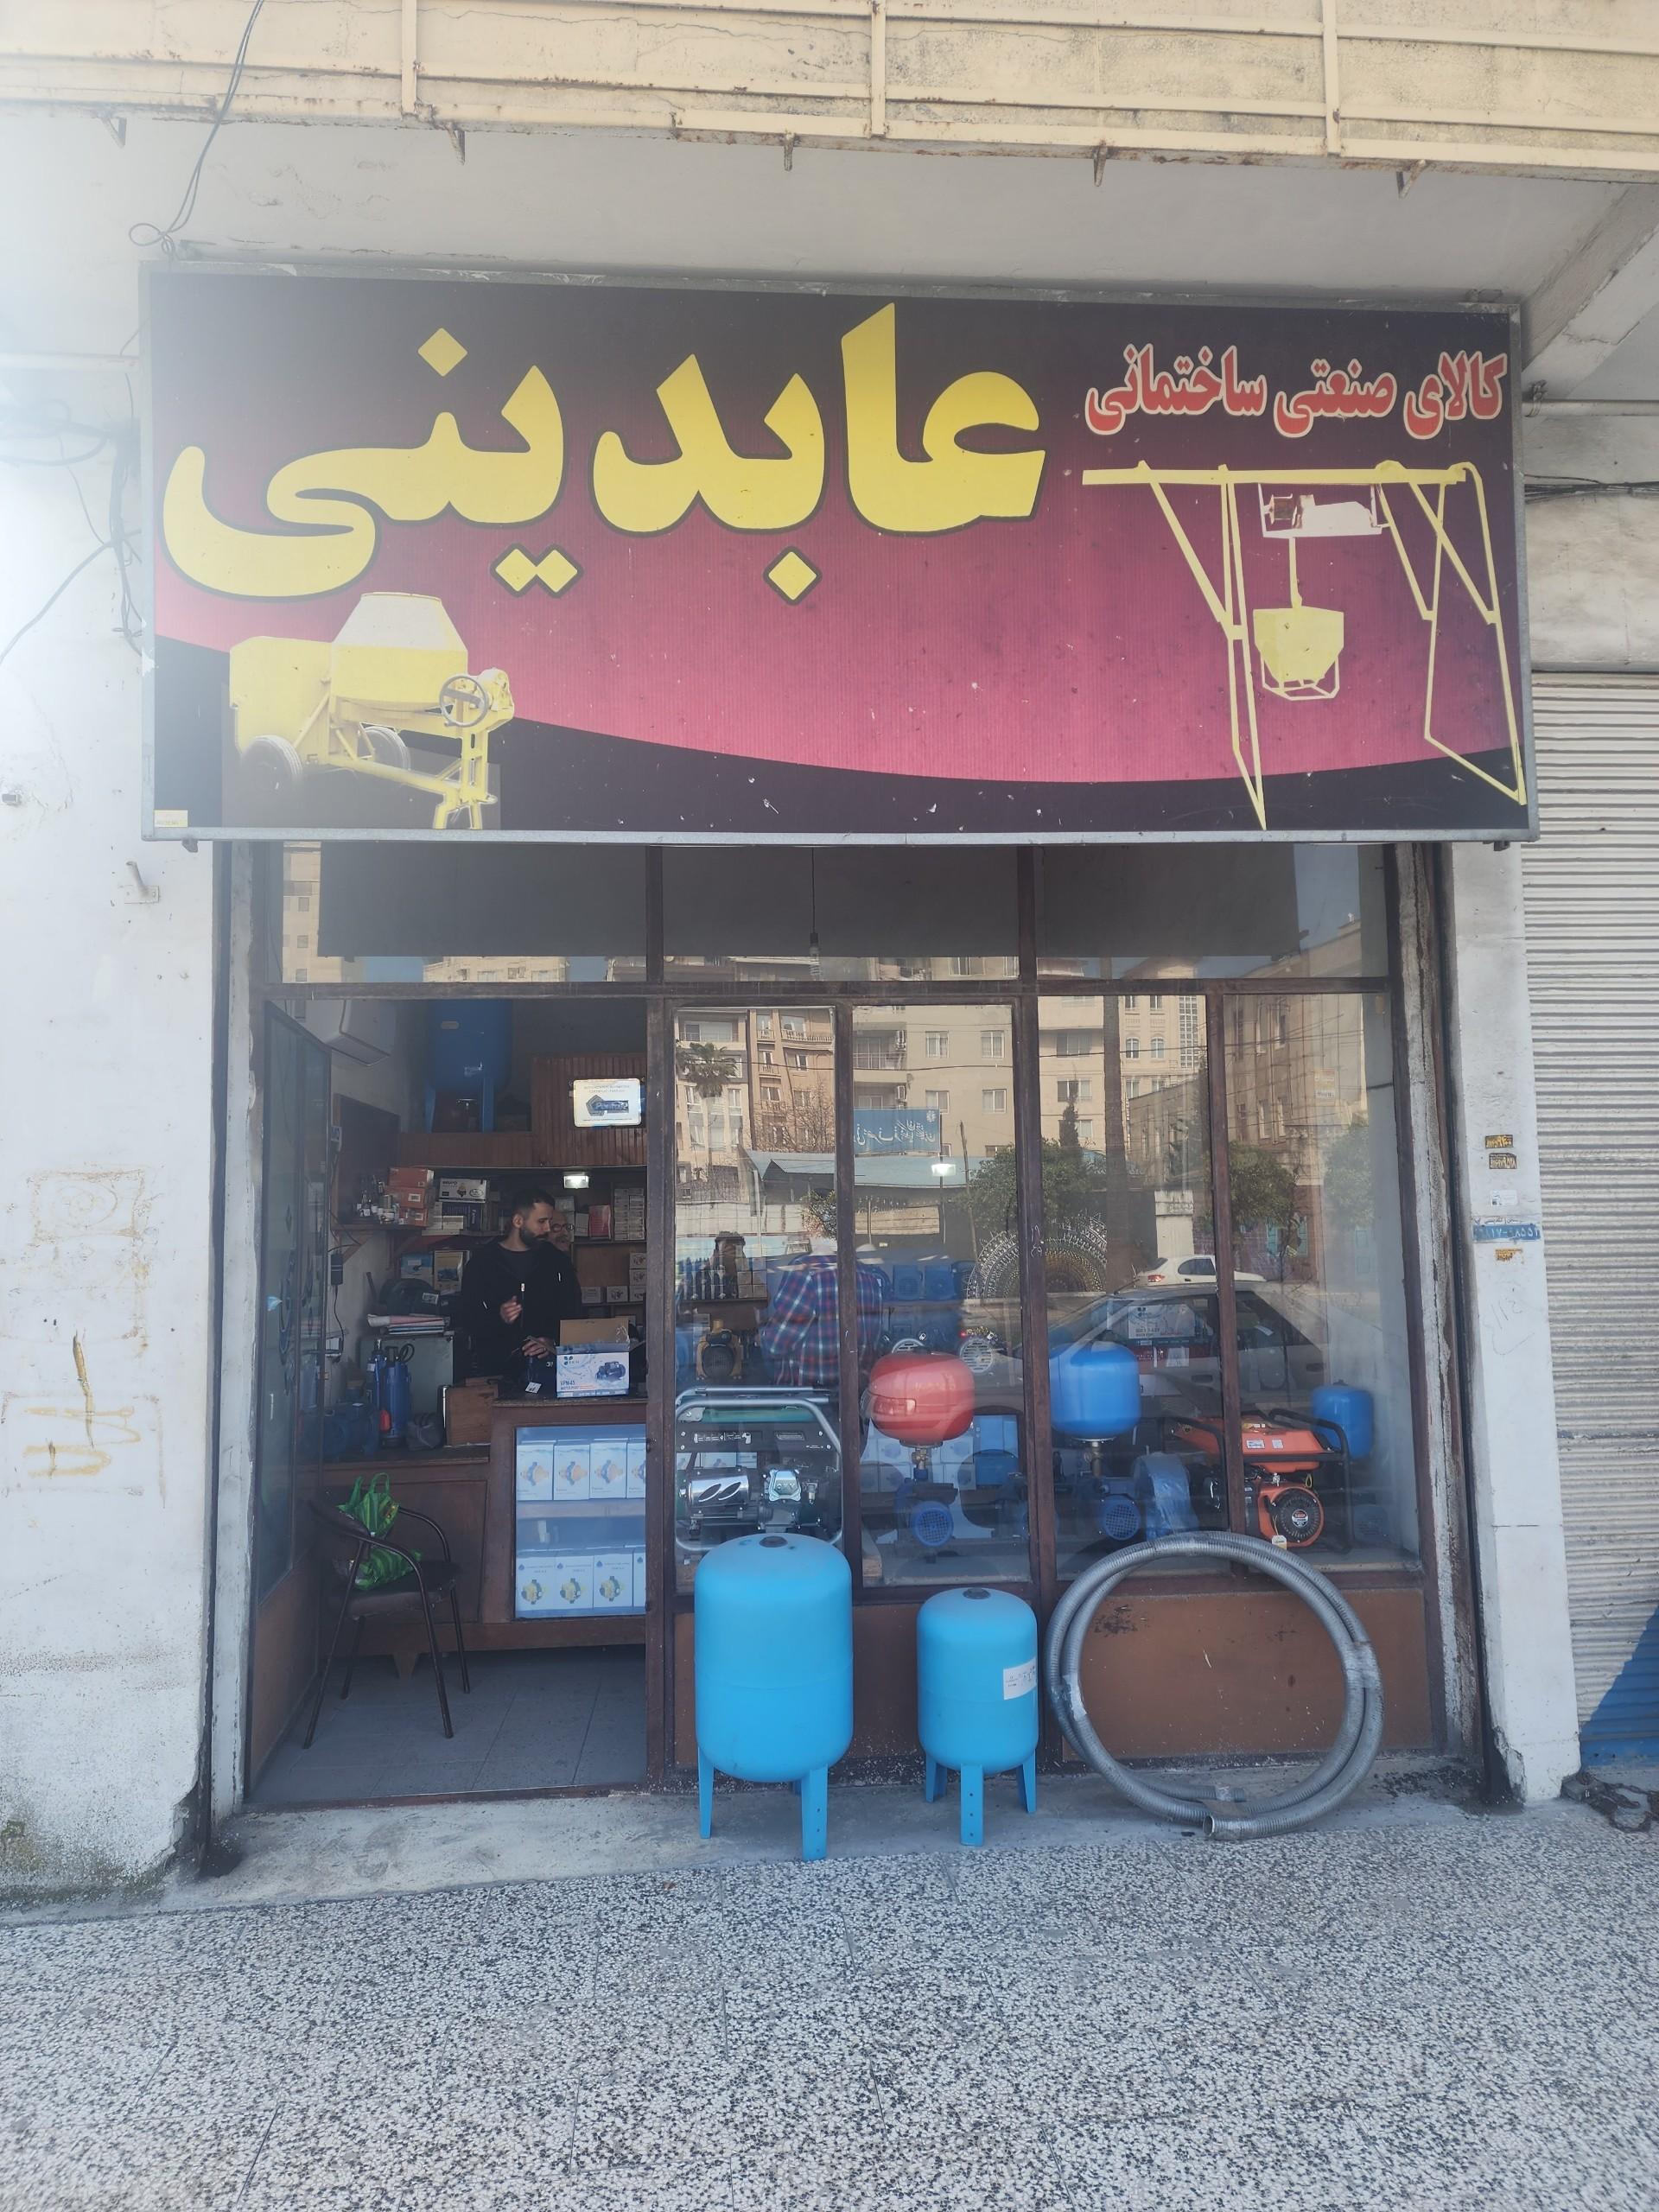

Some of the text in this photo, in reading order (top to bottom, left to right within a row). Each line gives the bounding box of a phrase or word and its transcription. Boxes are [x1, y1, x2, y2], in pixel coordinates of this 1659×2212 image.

[162, 302, 1046, 603] عابدینی
[1085, 343, 1508, 440] کالای صنعتی ساختمانی
